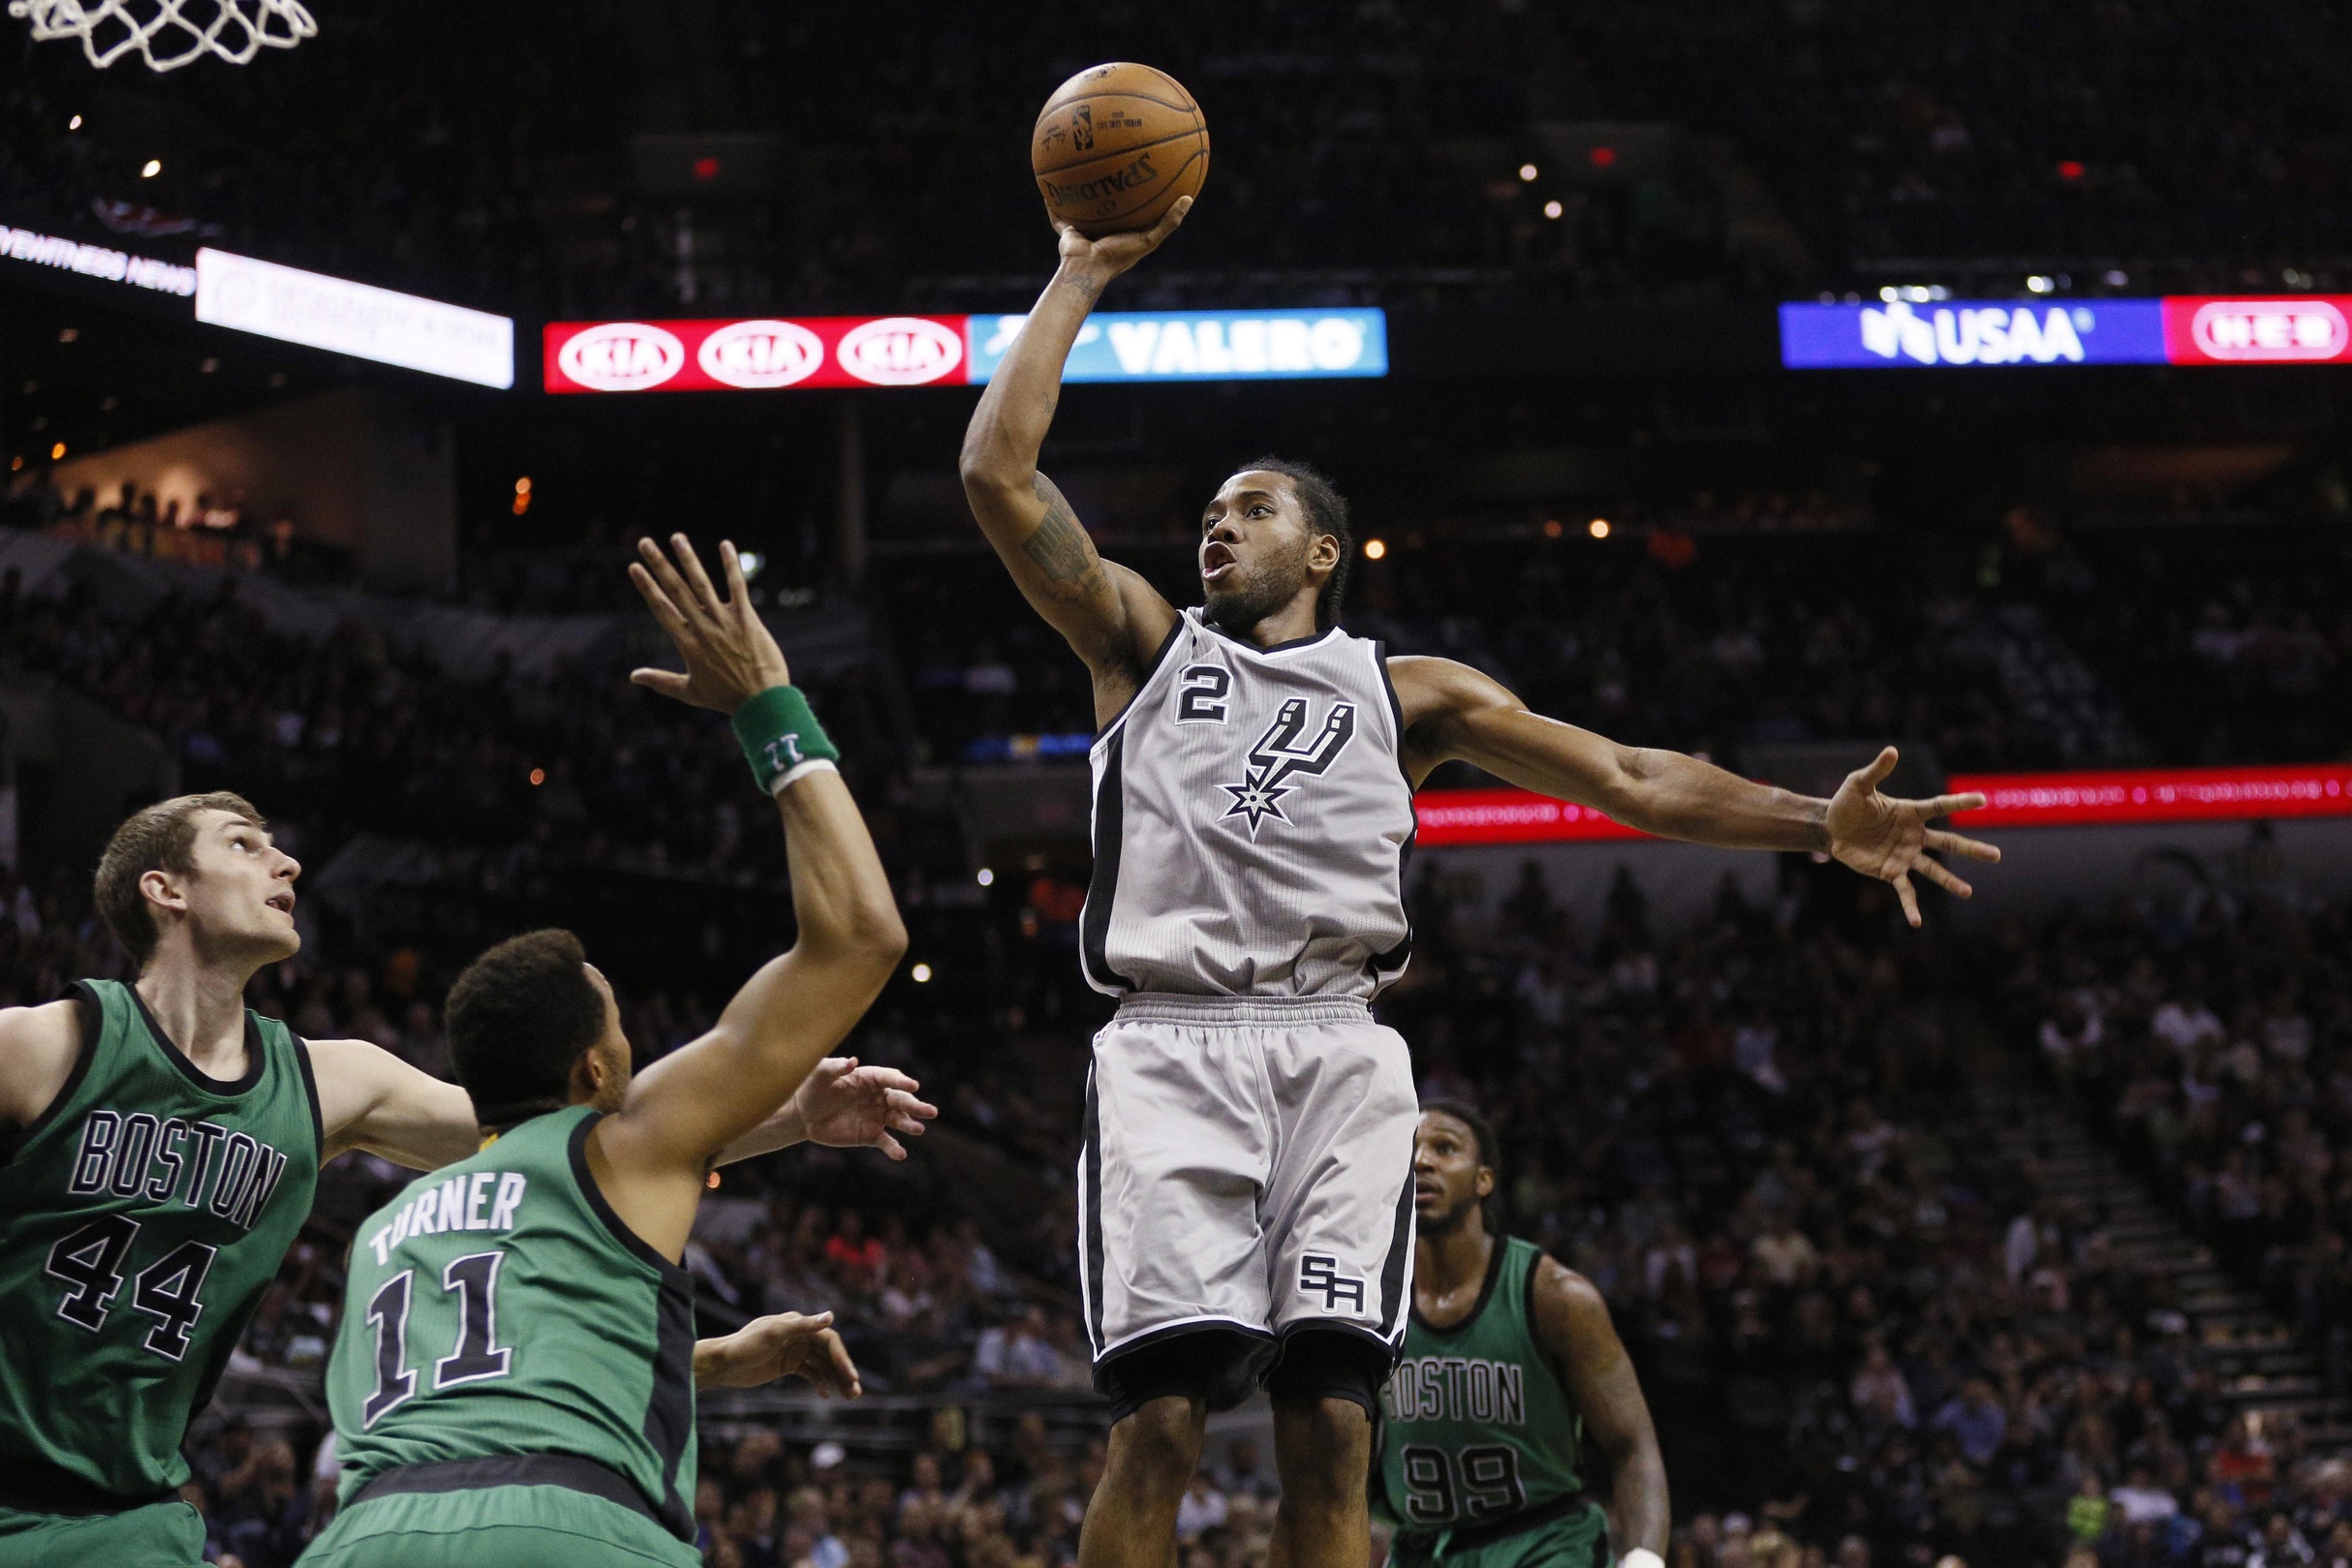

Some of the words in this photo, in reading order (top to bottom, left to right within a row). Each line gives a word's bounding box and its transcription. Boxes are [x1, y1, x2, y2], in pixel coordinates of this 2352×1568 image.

[1044, 152, 1159, 206] SPALDING
[127, 258, 197, 295] NEWS
[580, 337, 666, 377] KIA
[720, 334, 805, 375] KIA
[859, 332, 944, 372] KIA
[1107, 318, 1364, 374] VALERO
[1934, 307, 2085, 364] USAA
[1175, 663, 1234, 725] 2
[68, 1110, 288, 1231] BOSTON
[368, 1171, 527, 1267] TURNER
[46, 1214, 203, 1362] 44
[1297, 1250, 1368, 1317] SA
[361, 1250, 512, 1430] 11
[1400, 1442, 1528, 1523] 99
